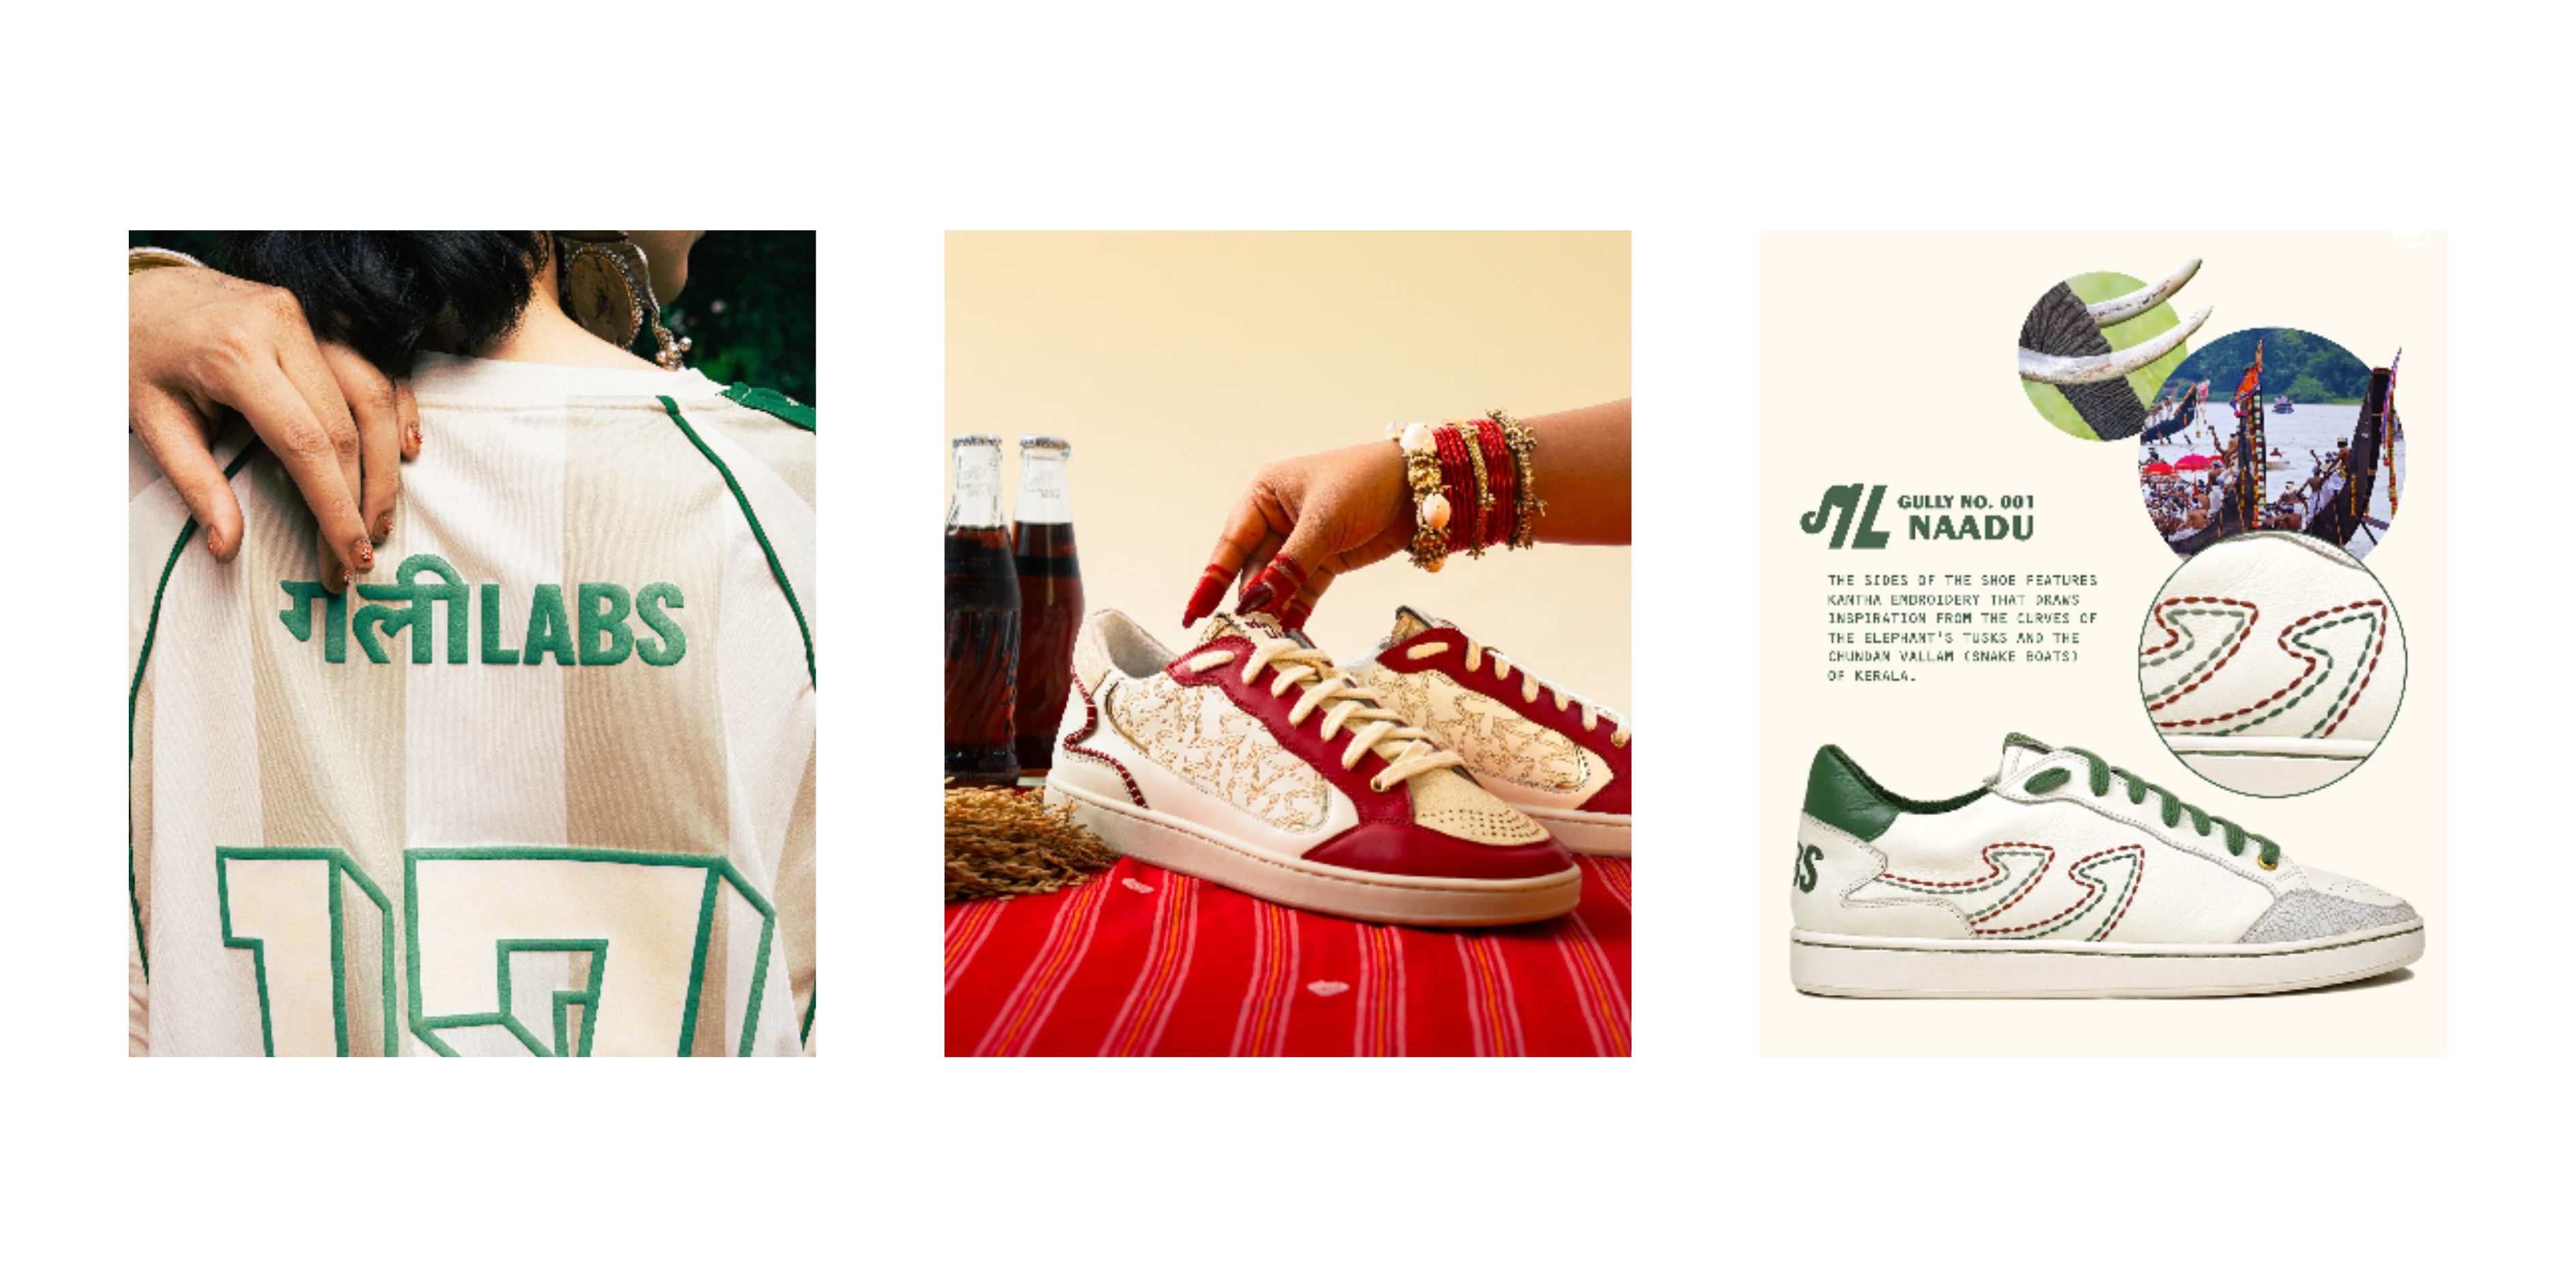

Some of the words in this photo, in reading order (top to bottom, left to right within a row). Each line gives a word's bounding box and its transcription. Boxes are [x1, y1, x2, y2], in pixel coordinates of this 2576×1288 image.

[1897, 495, 1954, 510] GULLY
[1961, 495, 1993, 510] NO.
[2000, 495, 2034, 510] 001
[1909, 515, 2034, 542] NAADU
[1827, 574, 1854, 586] THE
[1865, 574, 1908, 586] SIDES
[1917, 574, 1935, 586] OF
[1944, 574, 1972, 586] THE
[1980, 574, 2016, 586] SHOE
[2027, 574, 2098, 586] FEATURES
[1827, 594, 1882, 606] KANTHA
[1891, 594, 1980, 606] EMBROIDERY
[1991, 594, 2025, 606] THAT
[2036, 594, 2080, 606] DRAWS
[481, 583, 687, 666] LABS
[1828, 613, 1926, 624] INSPIRATION
[1937, 613, 1972, 624] FROM
[1980, 613, 2008, 624] THE
[2017, 613, 2070, 624] CURVES
[2080, 613, 2098, 624] OF
[1827, 632, 1854, 644] THE
[1865, 630, 1954, 644] ELEPHANT'S
[1963, 632, 2008, 644] TUSKS
[2016, 632, 2044, 644] AND
[2053, 632, 2080, 644] THE
[1828, 650, 1890, 662] CHUNDAN
[1899, 650, 1954, 662] VALLAM
[1964, 650, 2016, 662] (SNAKE
[2026, 650, 2078, 662] BOATS)
[1827, 670, 1845, 681] OF
[1855, 670, 1916, 681] KERALA.
